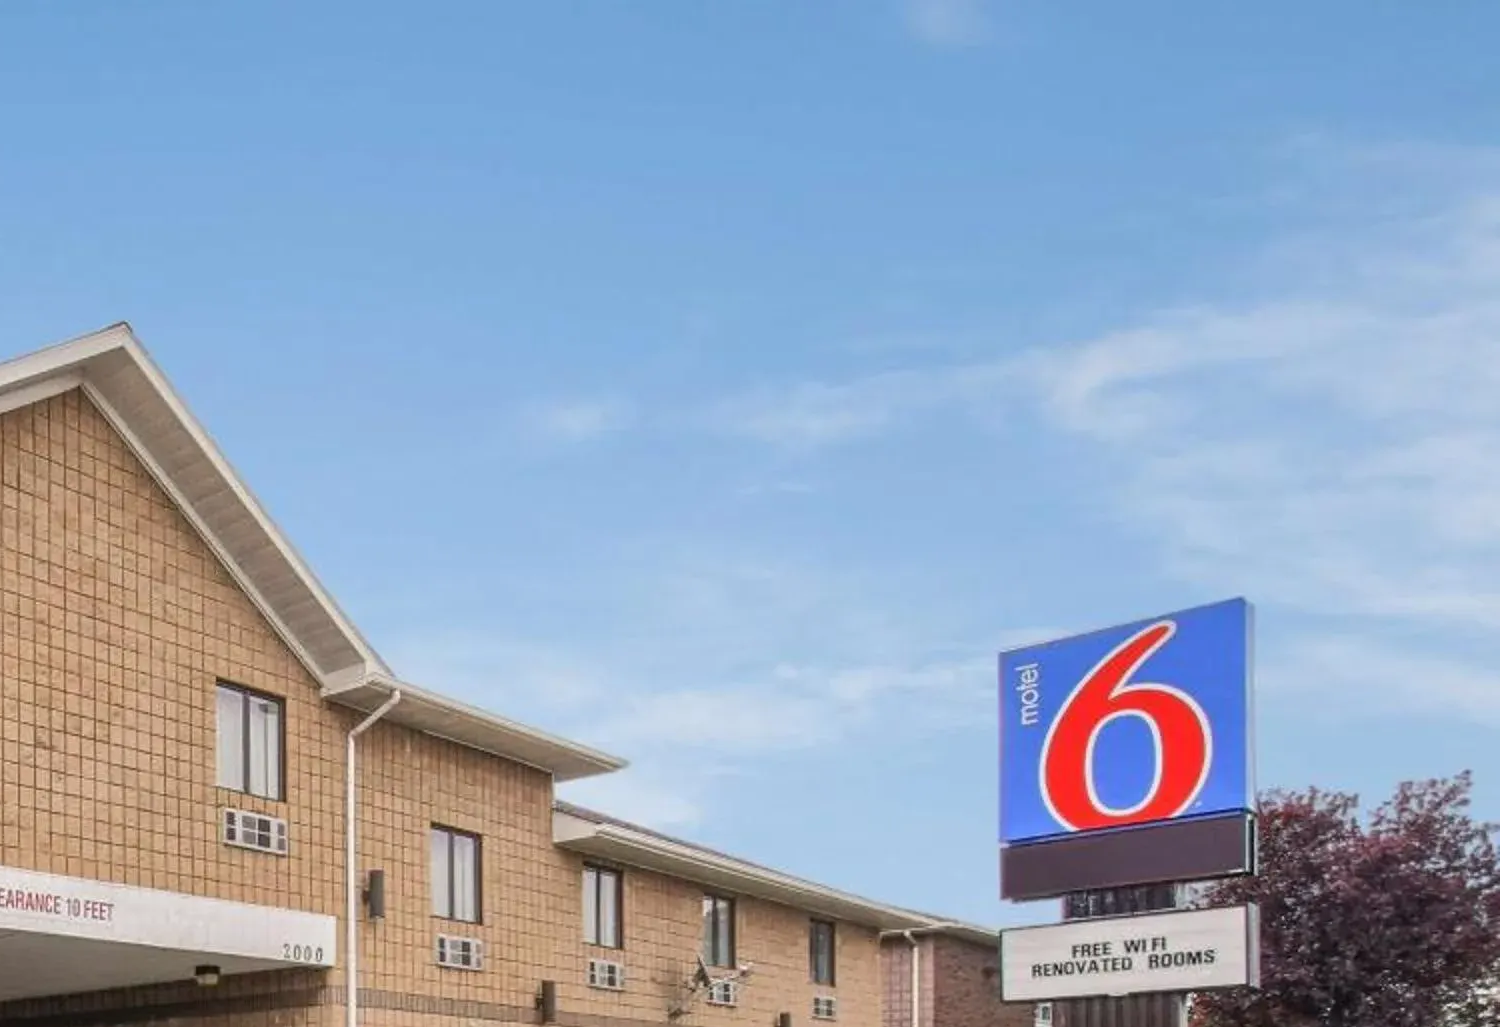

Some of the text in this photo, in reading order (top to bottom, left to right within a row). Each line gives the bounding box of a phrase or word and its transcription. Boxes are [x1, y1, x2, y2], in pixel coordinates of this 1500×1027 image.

[1014, 663, 1039, 725] motel
[1039, 619, 1213, 832] 6
[67, 898, 81, 917] 10
[83, 900, 115, 921] FEET
[283, 943, 324, 962] 2000
[1071, 941, 1112, 959] FREE
[1031, 949, 1216, 978] RENOVATED ROOMS
